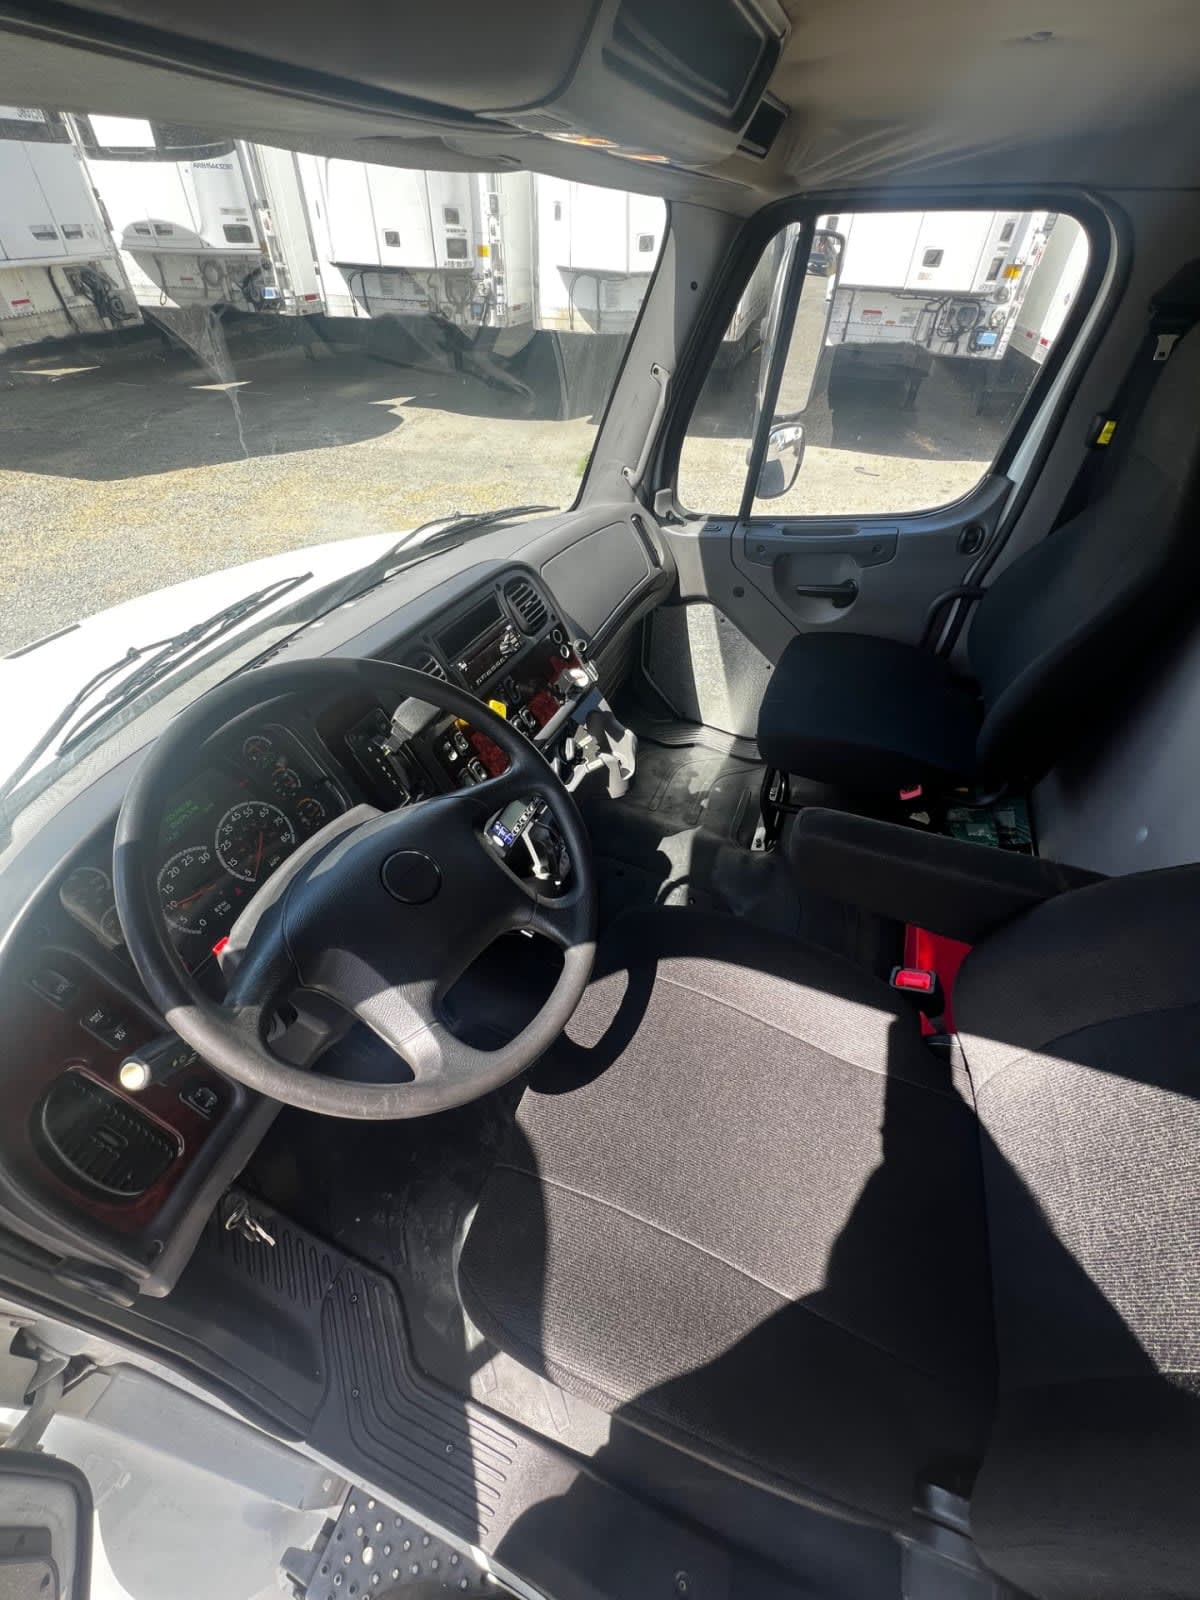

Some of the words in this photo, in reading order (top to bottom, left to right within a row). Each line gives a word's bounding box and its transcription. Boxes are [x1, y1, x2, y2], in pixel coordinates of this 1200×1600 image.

[231, 812, 241, 822] 45
[243, 807, 253, 818] 55
[260, 807, 269, 818] 65
[273, 816, 283, 826] 75
[222, 824, 233, 835] 35
[280, 832, 290, 842] 85
[221, 840, 232, 851] 25
[181, 854, 194, 866] 25
[198, 852, 210, 864] 30
[227, 857, 238, 867] 15
[167, 866, 180, 878] 20
[162, 884, 174, 894] 15
[166, 900, 178, 910] 10
[180, 915, 188, 924] 5
[199, 918, 207, 926] 0
